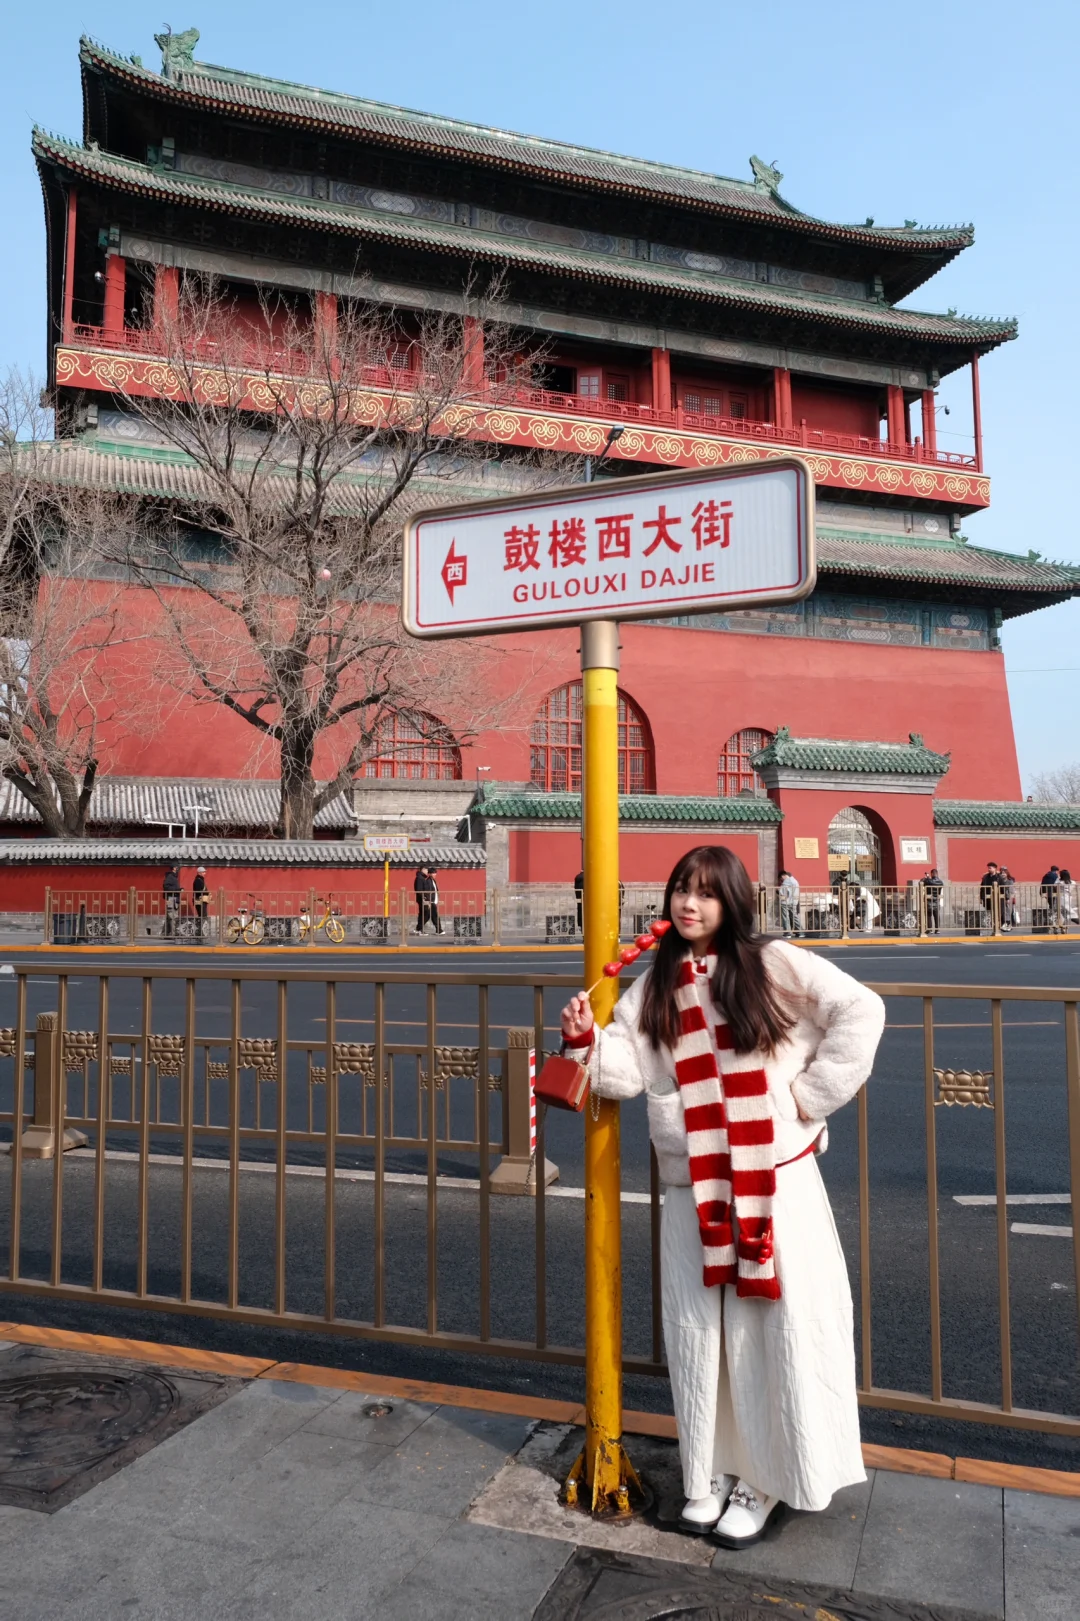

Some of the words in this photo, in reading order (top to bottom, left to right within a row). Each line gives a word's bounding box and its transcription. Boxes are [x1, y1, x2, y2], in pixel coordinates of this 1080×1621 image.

[503, 500, 734, 573] 鼓楼西大街
[446, 562, 465, 582] 西
[513, 572, 627, 604] GULOUXI
[641, 563, 715, 591] DAJIE
